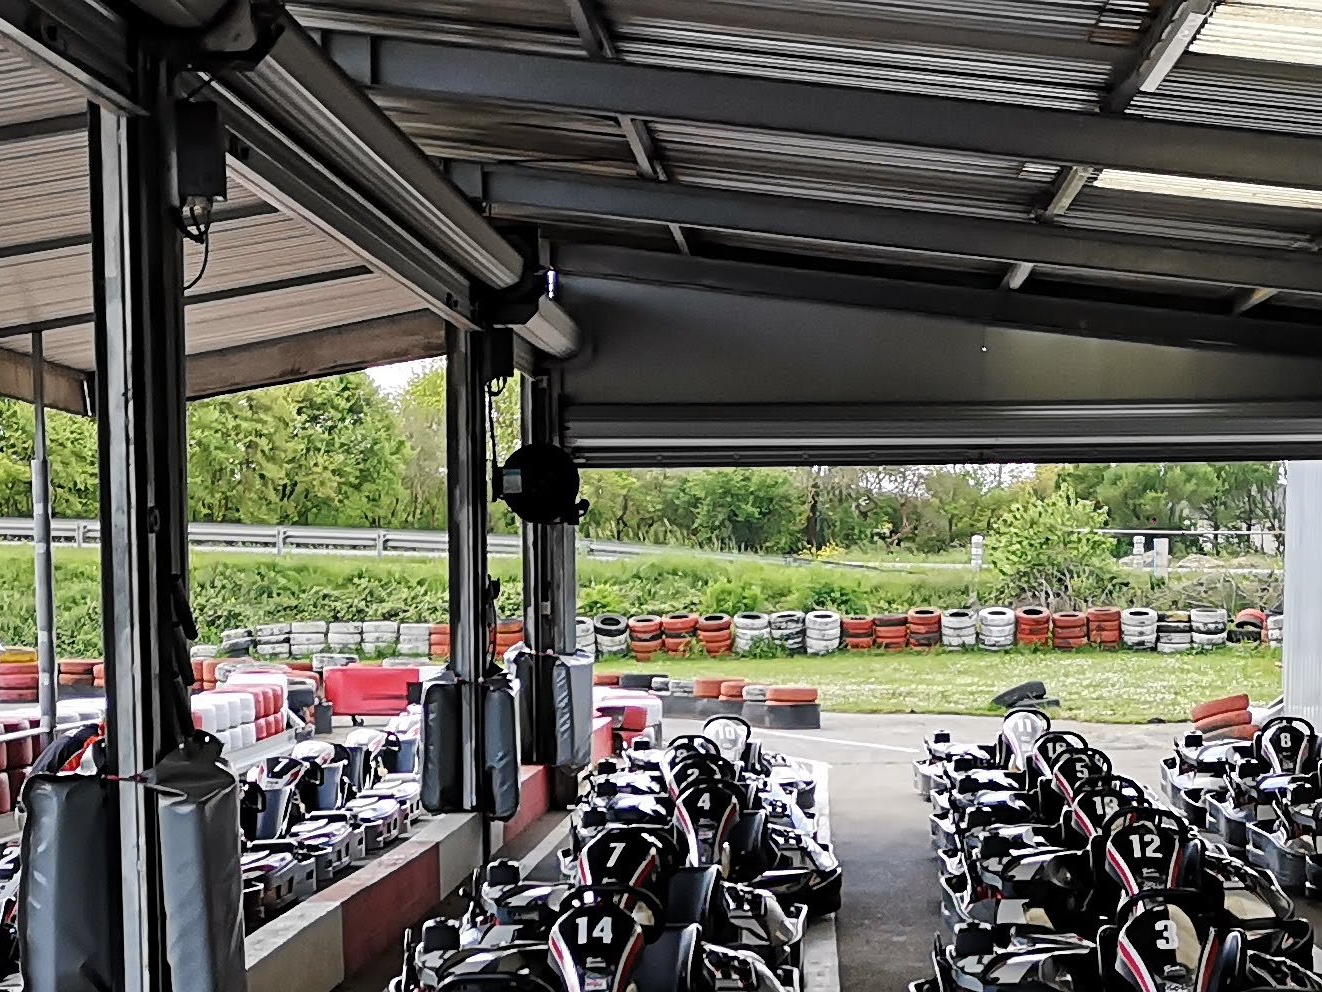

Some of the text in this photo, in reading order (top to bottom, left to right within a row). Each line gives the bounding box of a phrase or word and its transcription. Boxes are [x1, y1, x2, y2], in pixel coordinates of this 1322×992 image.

[717, 724, 736, 740] 10
[1017, 719, 1032, 732] 11
[1279, 732, 1292, 748] 8
[273, 758, 290, 773] 7
[1075, 761, 1089, 778] 5
[697, 792, 711, 810] 4
[1129, 834, 1163, 858] 12
[606, 842, 626, 868] 7
[576, 916, 613, 945] 14
[1154, 919, 1179, 950] 3
